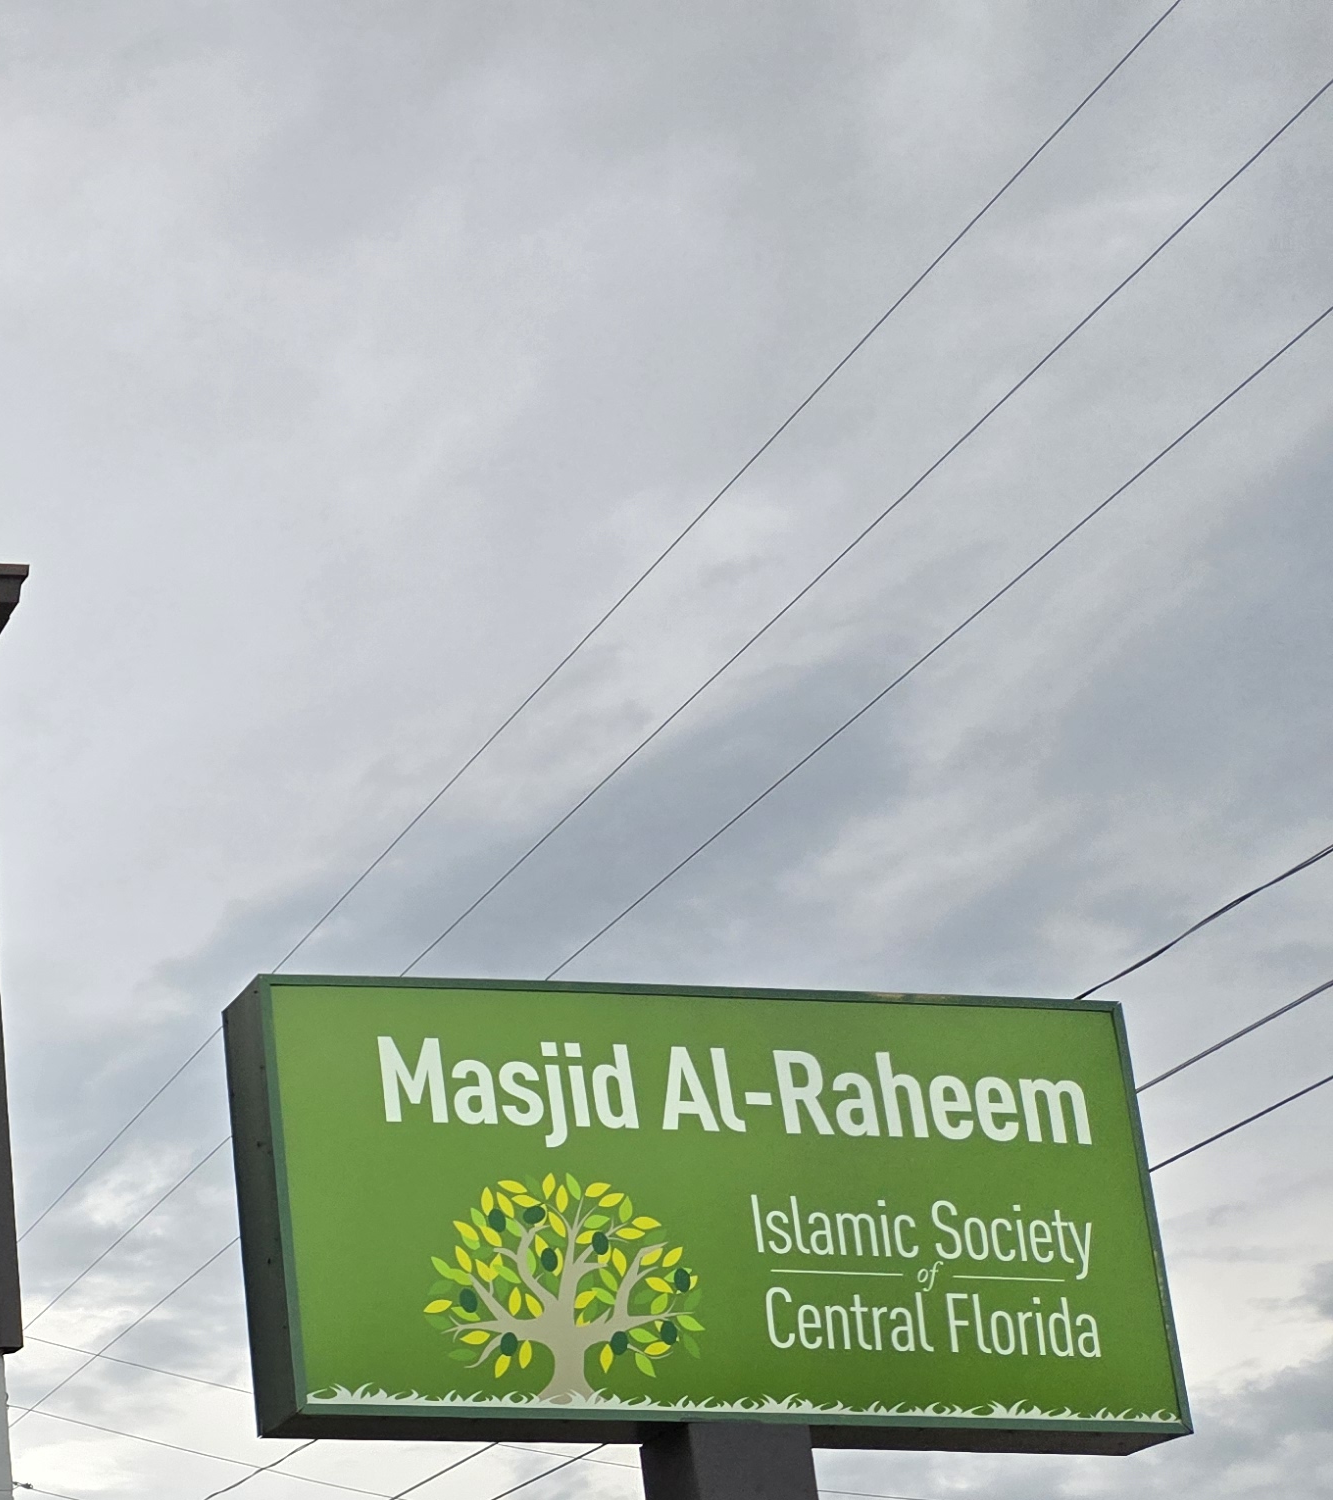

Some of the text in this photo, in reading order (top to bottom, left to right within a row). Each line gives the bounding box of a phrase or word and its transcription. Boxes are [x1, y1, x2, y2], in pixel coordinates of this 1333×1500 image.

[376, 1035, 1094, 1148] Masjid Al-Raheem
[750, 1193, 1093, 1281] Islamic Society
[917, 1260, 943, 1291] of
[766, 1286, 1102, 1359] Central Florida
